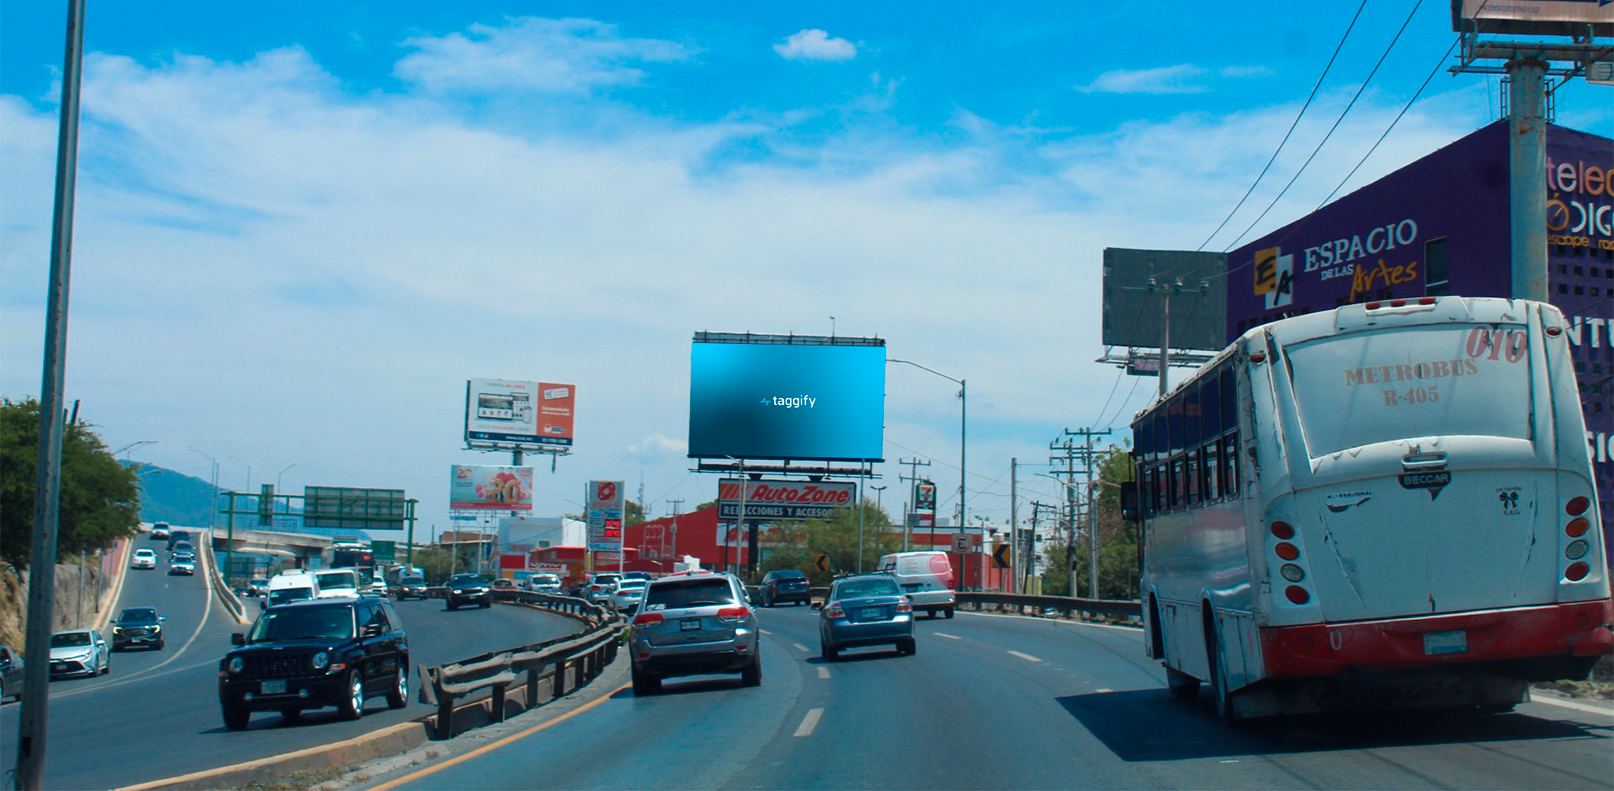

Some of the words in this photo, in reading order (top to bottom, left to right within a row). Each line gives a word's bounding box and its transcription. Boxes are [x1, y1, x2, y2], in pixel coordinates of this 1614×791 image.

[1303, 218, 1418, 273] ESPACIO
[1320, 269, 1334, 281] DE
[1334, 264, 1354, 278] LAS
[1349, 258, 1418, 302] Artes
[1466, 325, 1528, 364] 010
[1344, 358, 1478, 386] METROBUS
[772, 394, 816, 409] taggify
[1383, 385, 1440, 407] R-405
[1404, 473, 1450, 485] BECCAR
[750, 484, 851, 505] AutoZone
[786, 508, 794, 517] Y
[957, 538, 966, 550] E
